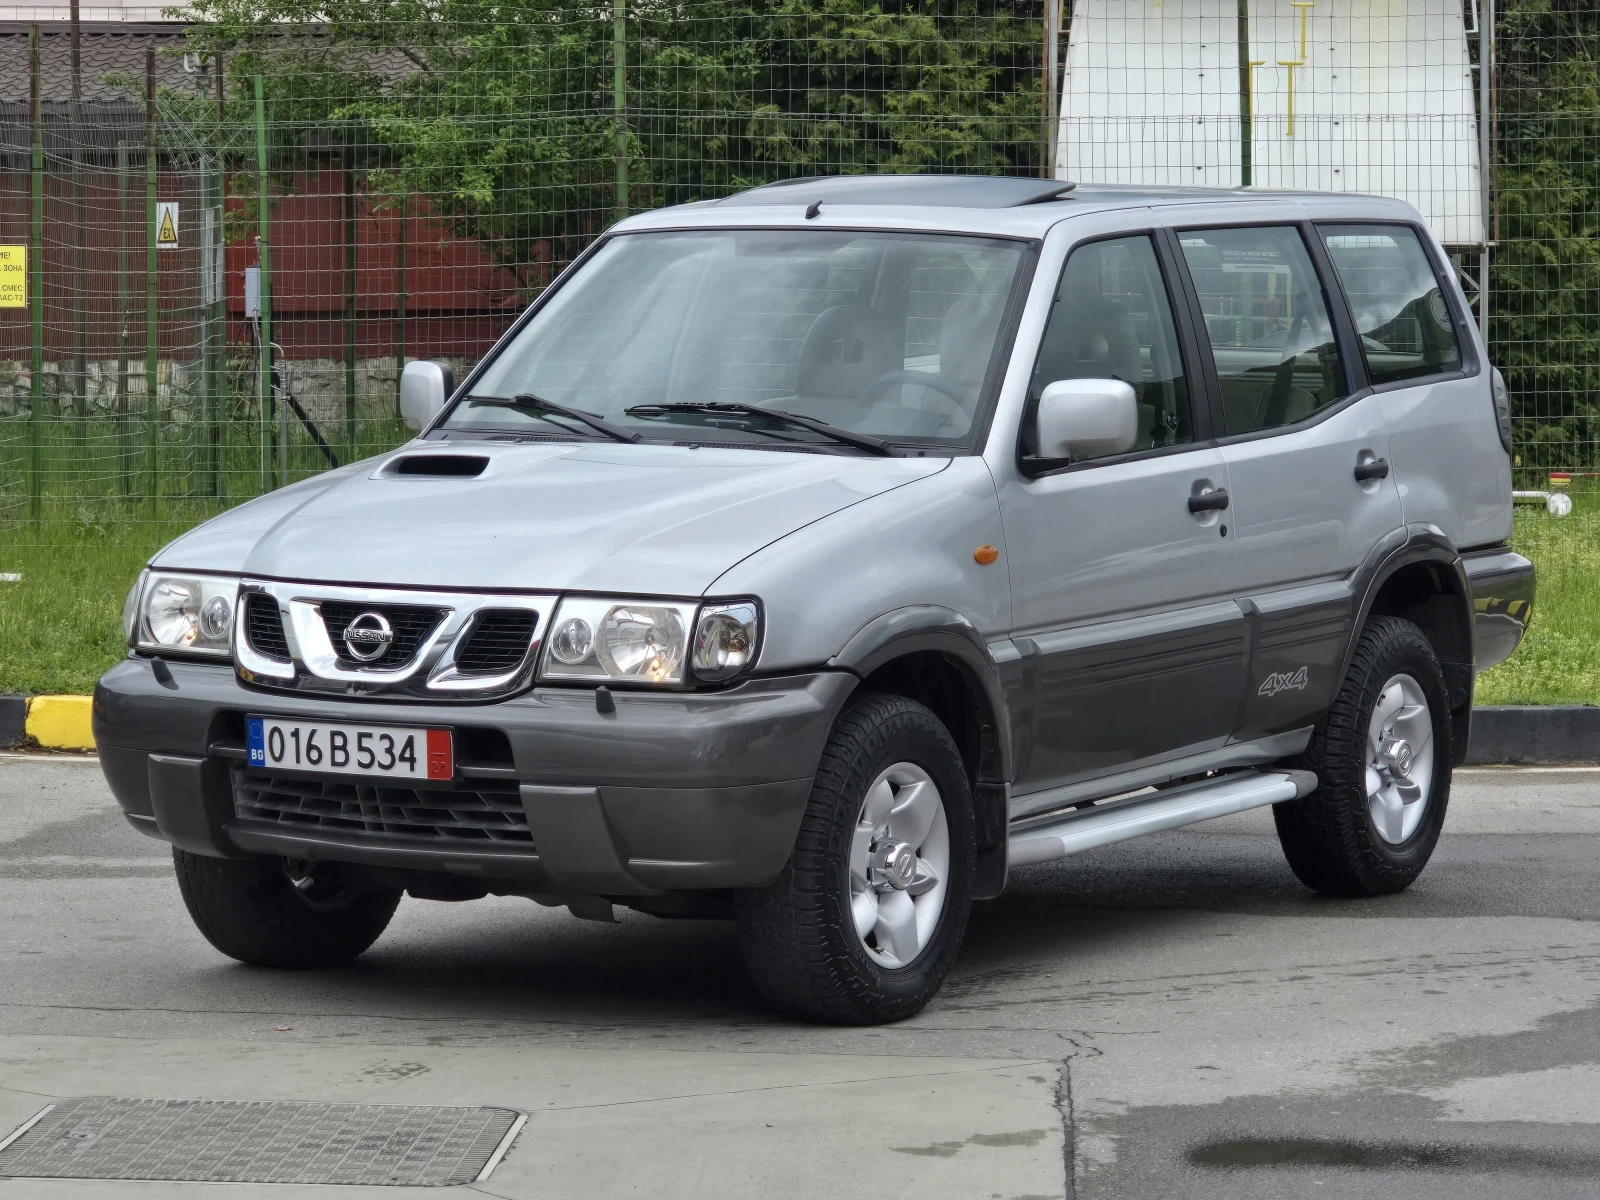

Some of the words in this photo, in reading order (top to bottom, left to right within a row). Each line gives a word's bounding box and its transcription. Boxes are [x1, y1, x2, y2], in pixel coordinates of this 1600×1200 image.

[3, 264, 23, 272] ЗОНА
[346, 630, 386, 641] NISSAN
[251, 748, 264, 761] BG
